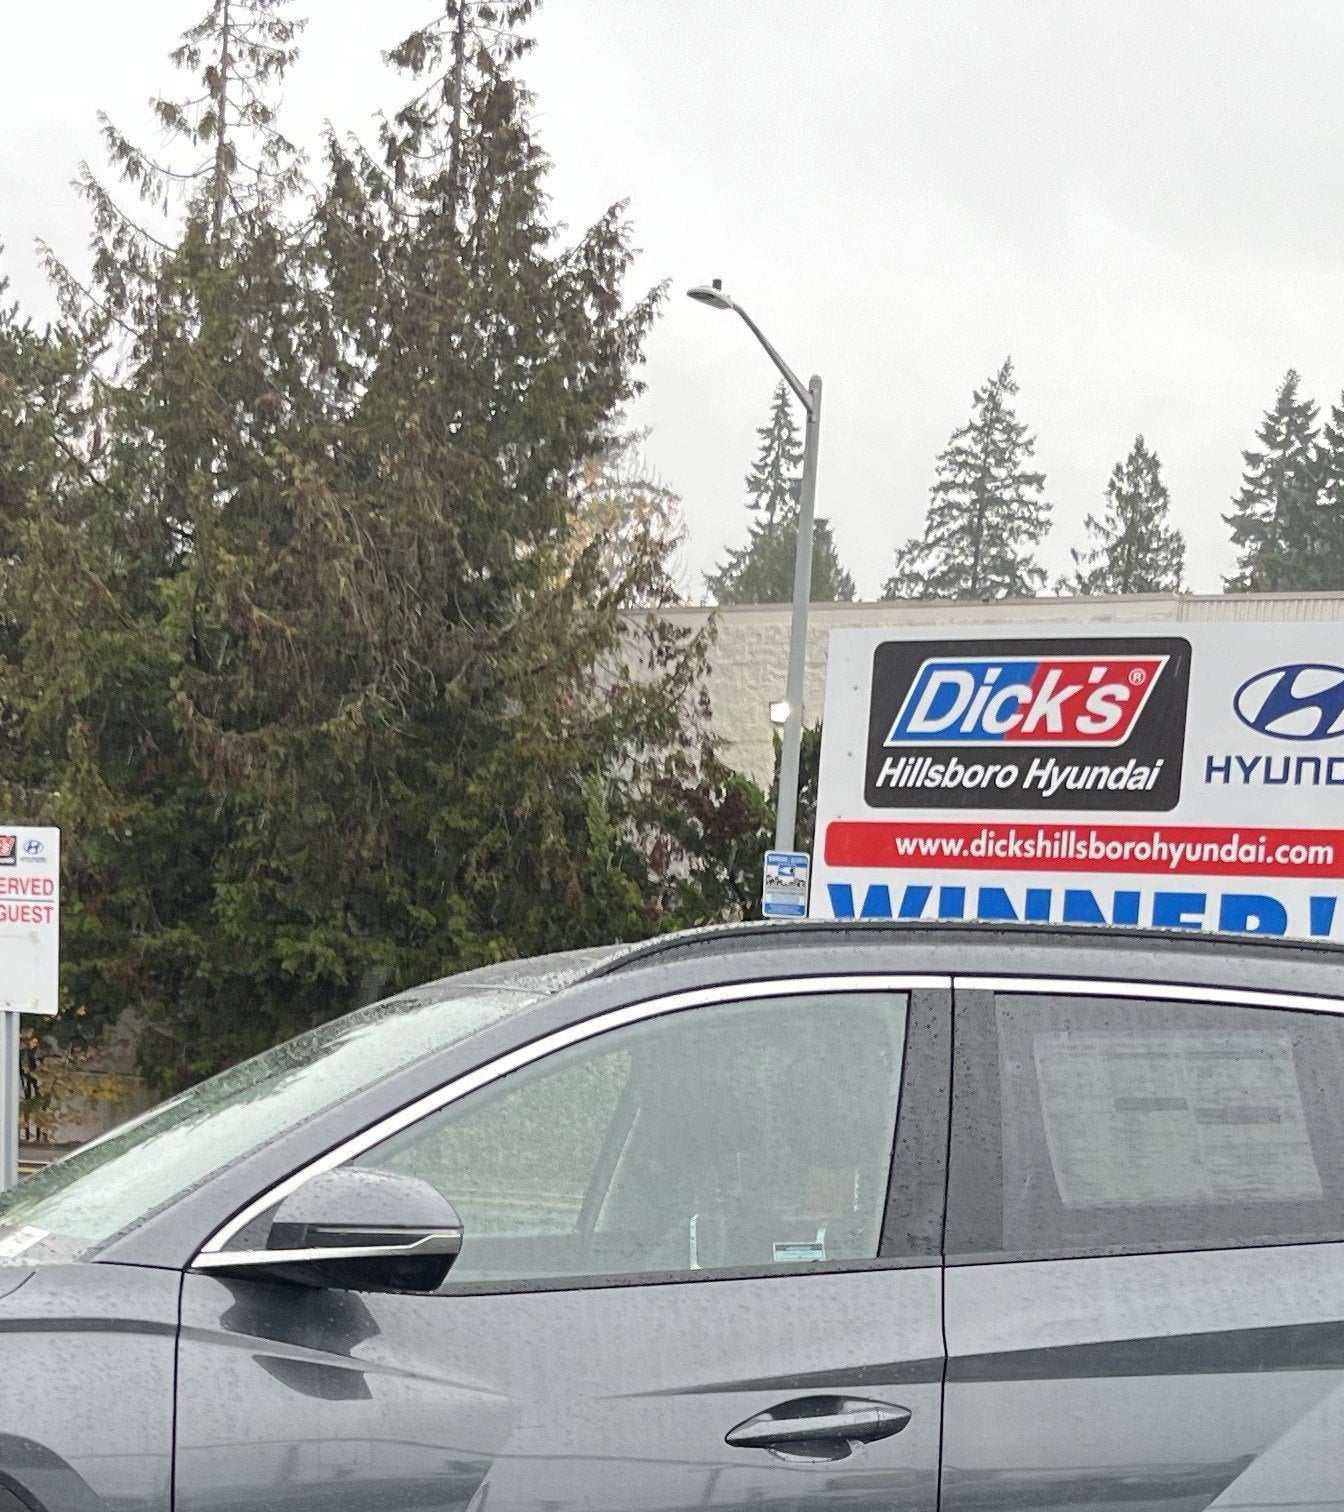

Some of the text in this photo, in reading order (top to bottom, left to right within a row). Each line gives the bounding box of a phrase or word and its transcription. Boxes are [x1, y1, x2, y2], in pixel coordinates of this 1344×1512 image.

[875, 756, 1165, 798] Hillsboro Hyundai
[894, 828, 1334, 870] www.dickshillsborohyundai.com
